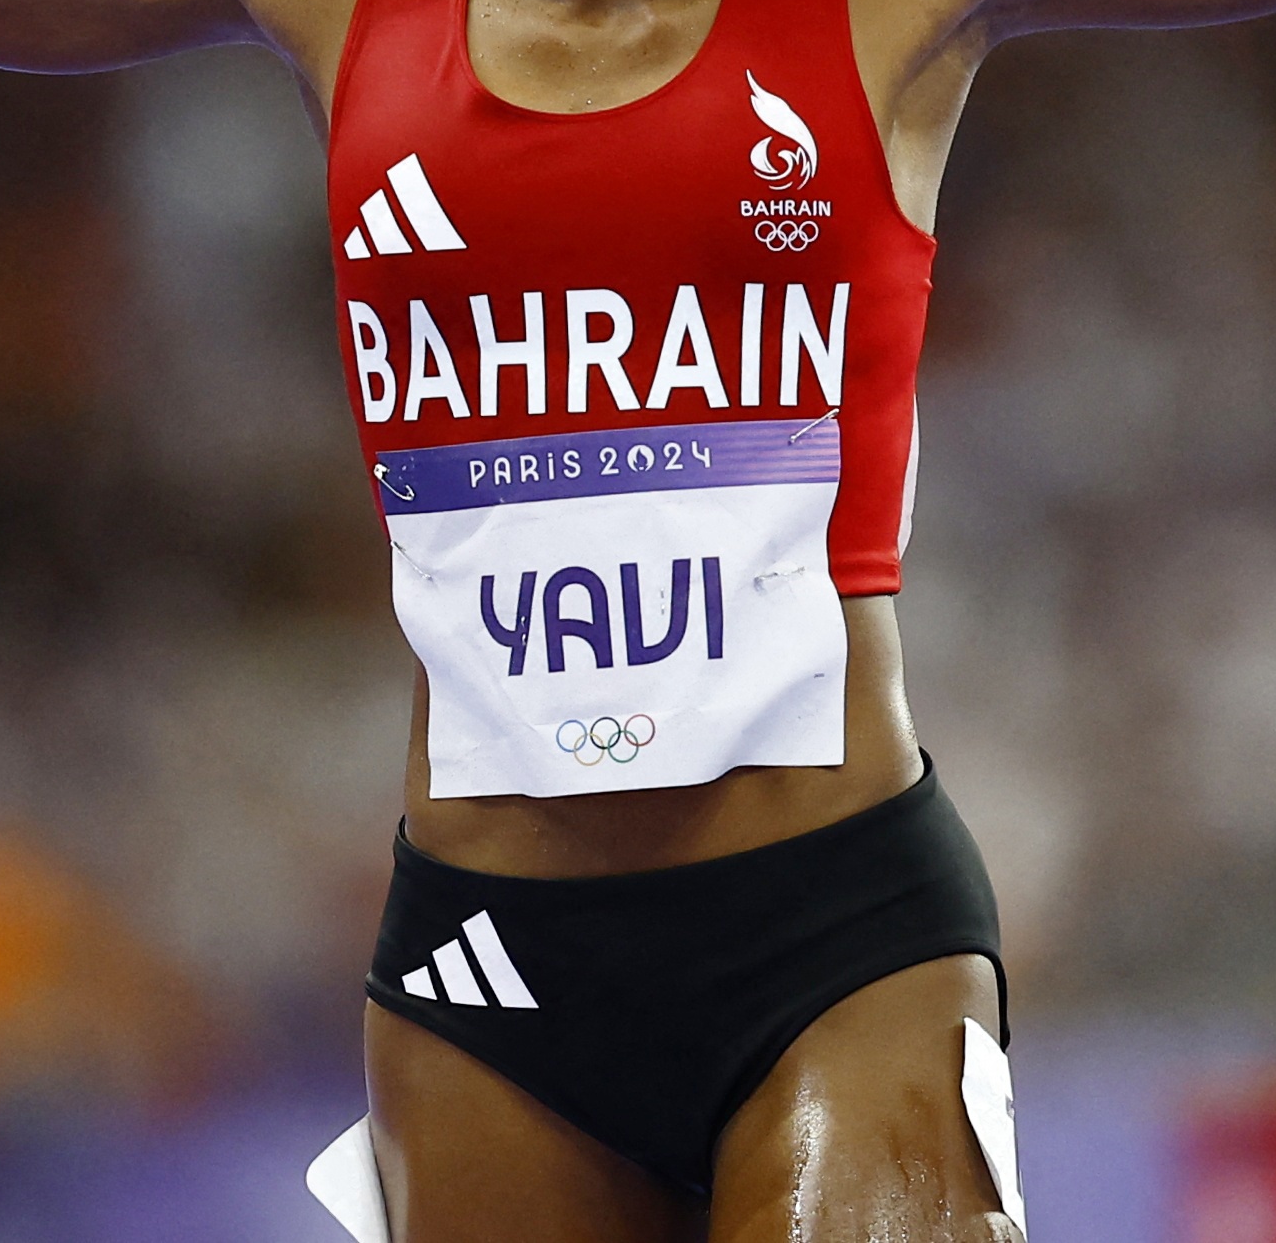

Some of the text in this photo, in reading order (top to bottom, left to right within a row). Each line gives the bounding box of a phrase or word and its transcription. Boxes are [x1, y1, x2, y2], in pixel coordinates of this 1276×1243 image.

[740, 199, 832, 217] BAHRAIN
[347, 283, 851, 423] BAHRAIN
[599, 440, 712, 476] 2024
[480, 557, 724, 676] YAVI
